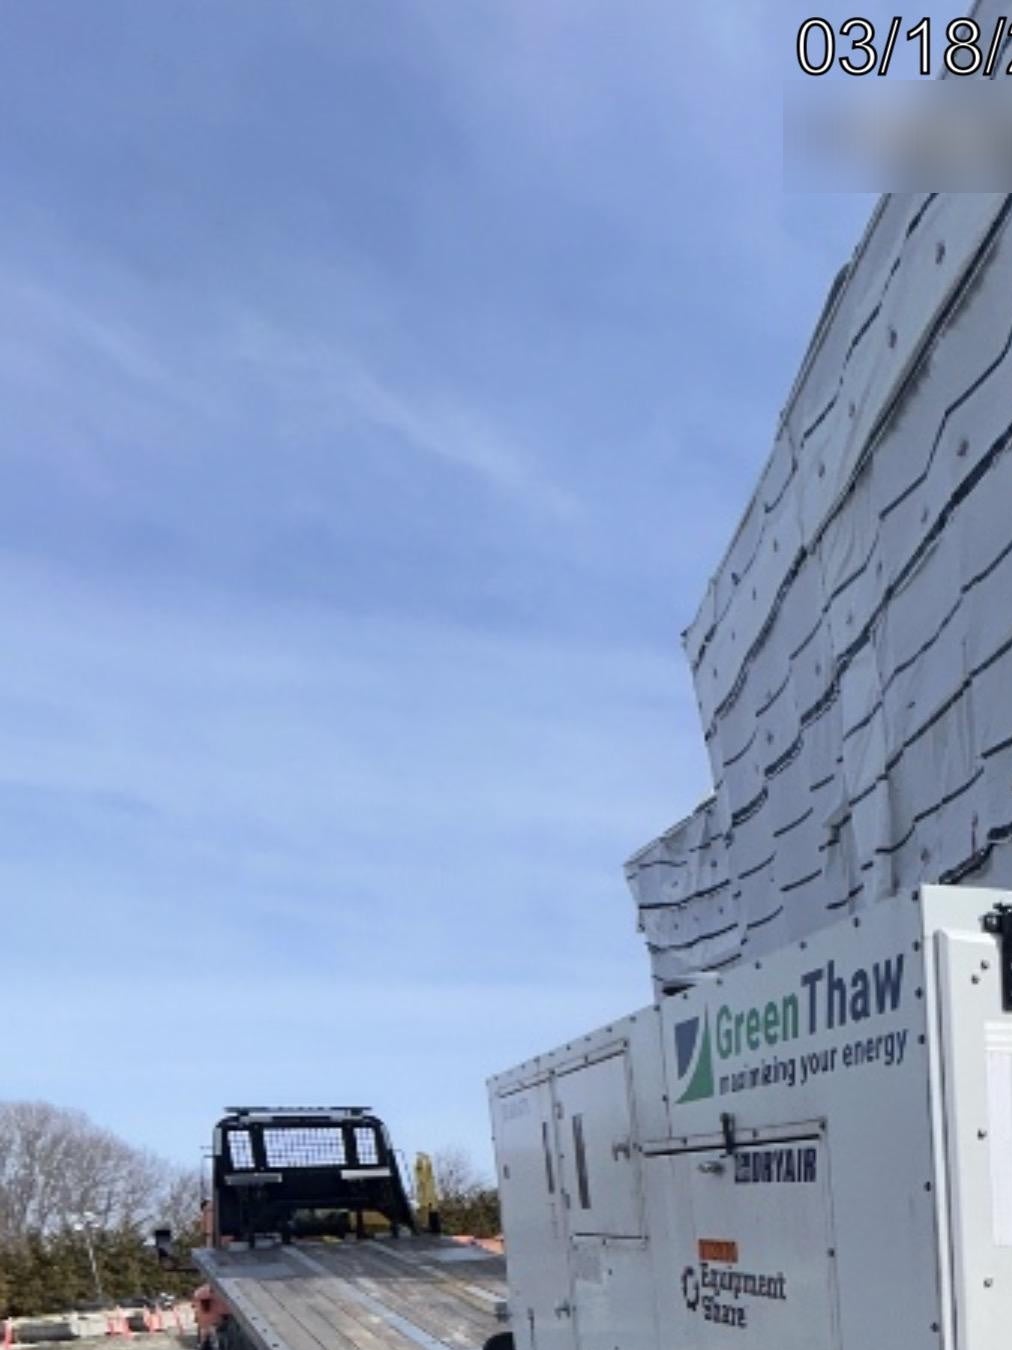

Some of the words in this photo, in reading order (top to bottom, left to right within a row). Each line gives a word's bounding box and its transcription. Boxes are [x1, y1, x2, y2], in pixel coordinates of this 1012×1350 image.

[801, 1047, 838, 1085] your
[843, 1028, 908, 1068] energy
[701, 1262, 787, 1300] Equipment
[702, 1295, 747, 1329] Share
